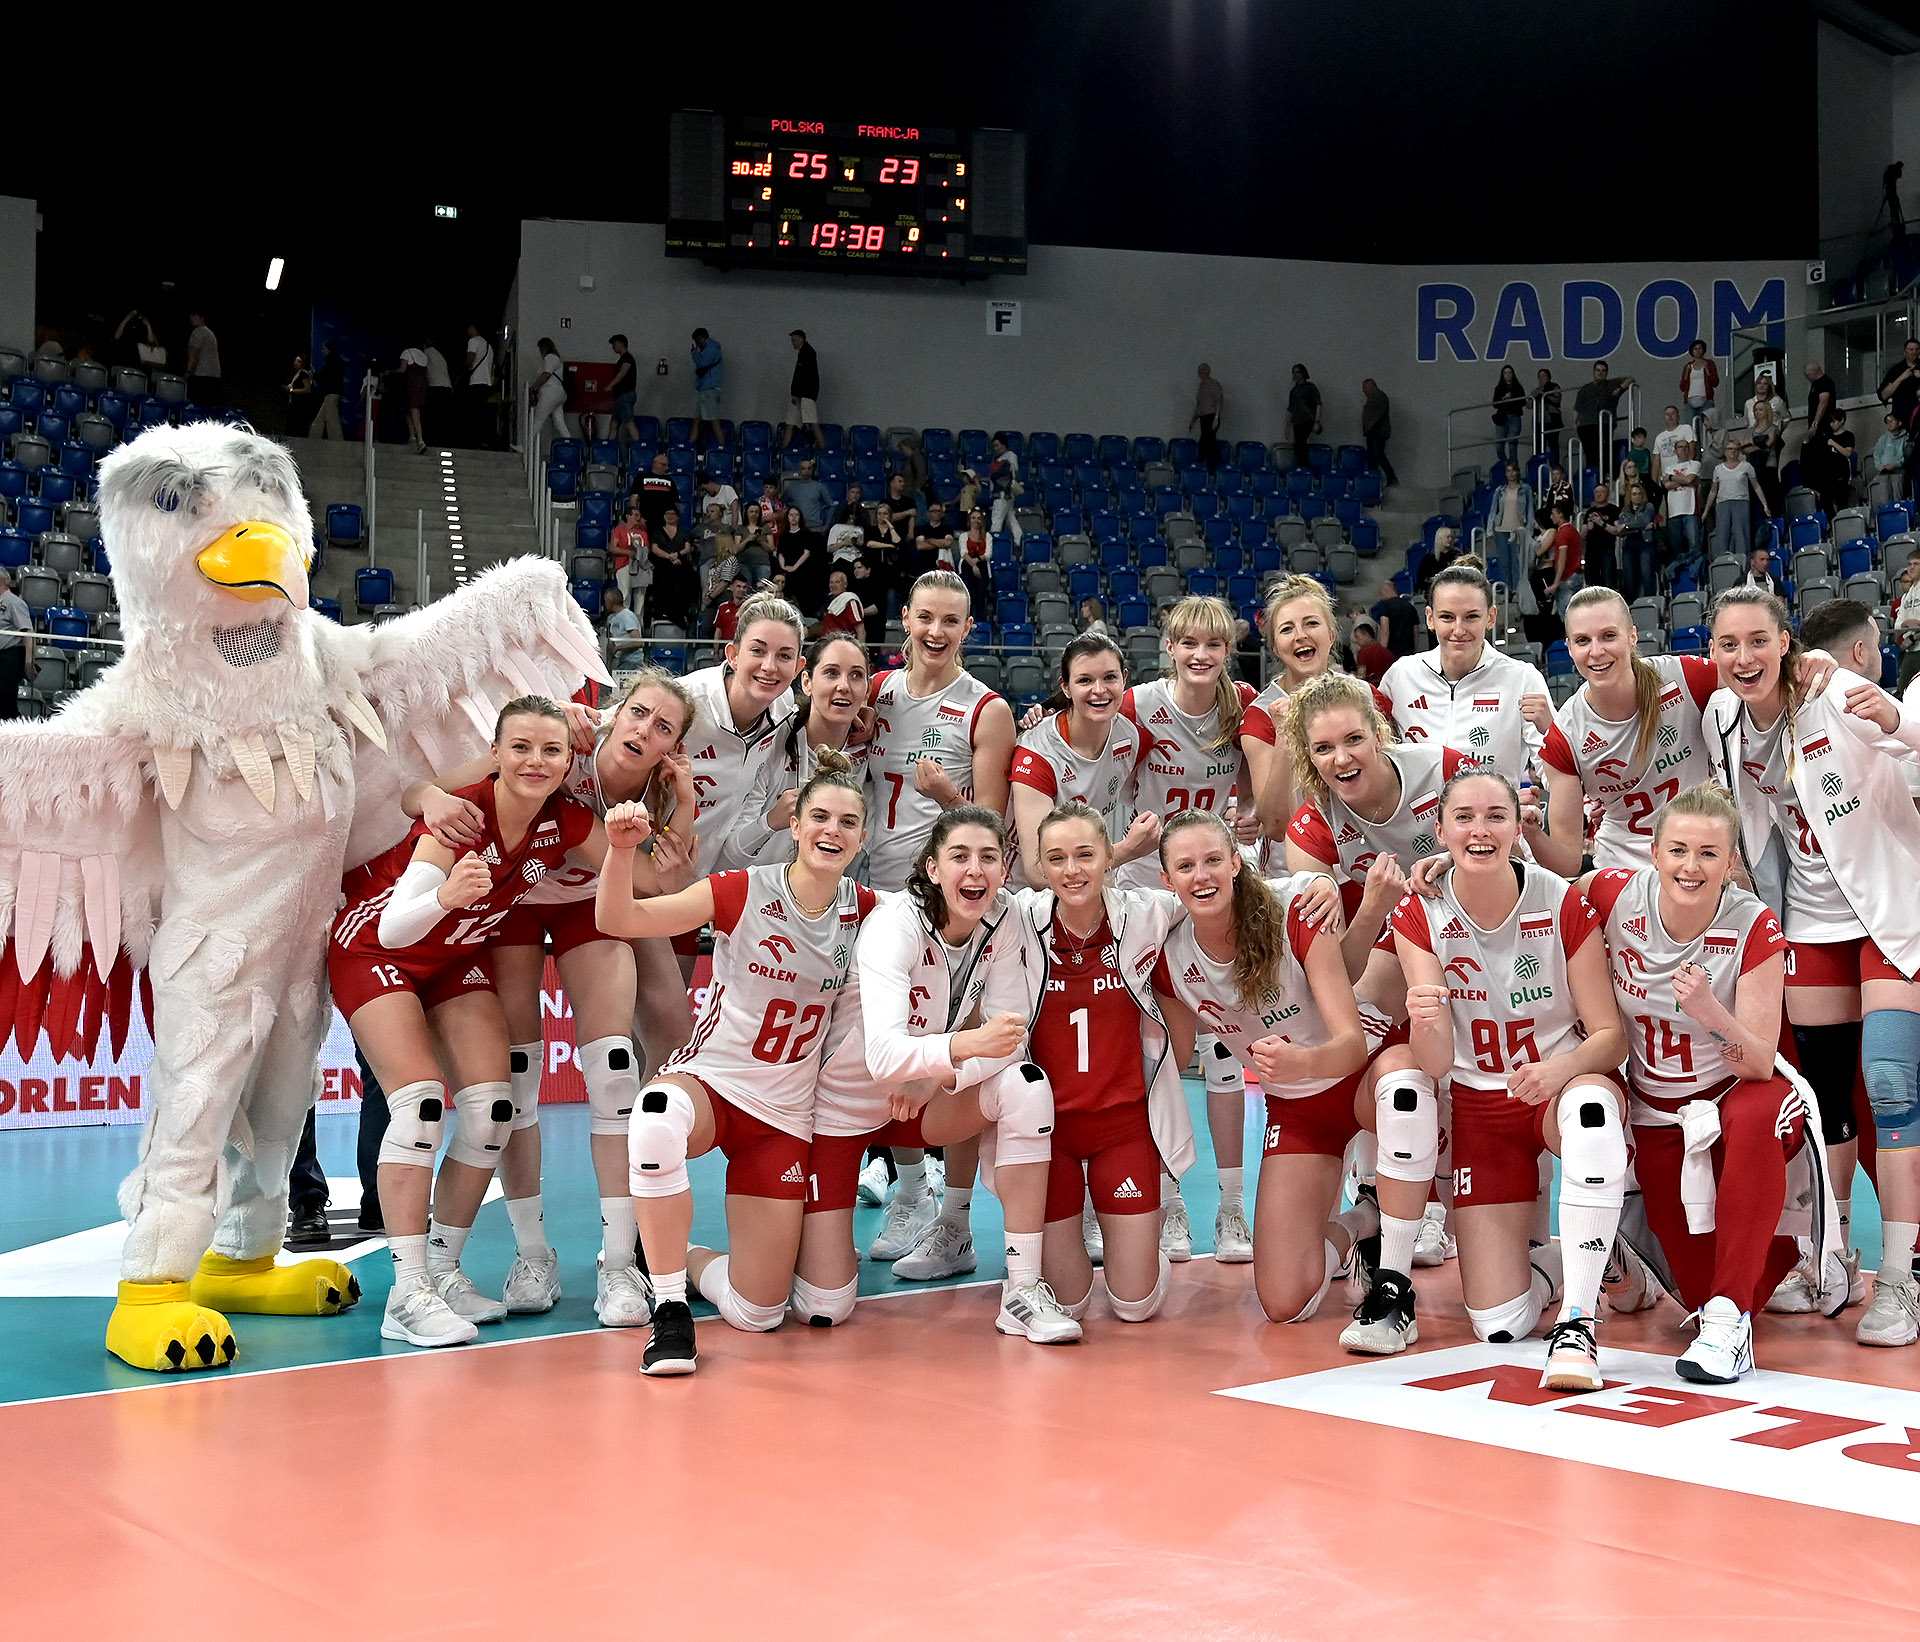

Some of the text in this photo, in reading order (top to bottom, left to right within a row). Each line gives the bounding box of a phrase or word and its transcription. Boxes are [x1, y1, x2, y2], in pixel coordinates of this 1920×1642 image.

[771, 119, 825, 134] POLSKA
[858, 125, 920, 140] FRANCJA
[789, 153, 828, 178] 25
[879, 158, 919, 184] 23
[955, 163, 965, 176] 3
[844, 168, 855, 181] 4
[761, 187, 772, 200] 2
[955, 198, 965, 210] 4
[811, 223, 885, 251] 19:38
[908, 228, 919, 242] 0
[1810, 268, 1823, 281] G
[995, 311, 1012, 332] F
[1416, 278, 1787, 362] RADOM
[1660, 695, 1685, 713] OLSKA
[936, 712, 963, 724] POLSKA
[1581, 740, 1609, 755] adidas
[1804, 745, 1833, 762] POLSKA
[1463, 751, 1495, 765] lus
[1655, 745, 1692, 774] plus
[1148, 762, 1185, 776] ORLEN
[1206, 762, 1235, 778] plus
[1599, 777, 1640, 793] ORLEN
[884, 771, 904, 830] 7
[1416, 808, 1438, 823] POLSK
[1824, 795, 1861, 826] plus
[760, 907, 788, 922] adidas
[444, 910, 509, 945] 12
[1439, 930, 1470, 939] adidas
[1521, 927, 1555, 939] POLSKA
[1621, 921, 1649, 942] adidas
[1703, 945, 1736, 955] POLSKA
[371, 964, 404, 987] 12
[748, 962, 798, 983] ORLEN
[462, 977, 490, 985] adidas
[820, 975, 847, 993] plu
[1093, 973, 1125, 994] plu
[1612, 969, 1649, 1000] ORLEN
[1450, 989, 1487, 1001] RLEN
[1510, 985, 1553, 1009] plus
[1261, 1002, 1301, 1029] plus
[752, 998, 826, 1064] 62
[1069, 1007, 1089, 1073] 1
[1471, 1018, 1541, 1073] 95
[1634, 1014, 1694, 1073] 14
[781, 1174, 804, 1183] adidas
[1113, 1190, 1143, 1199] adidas
